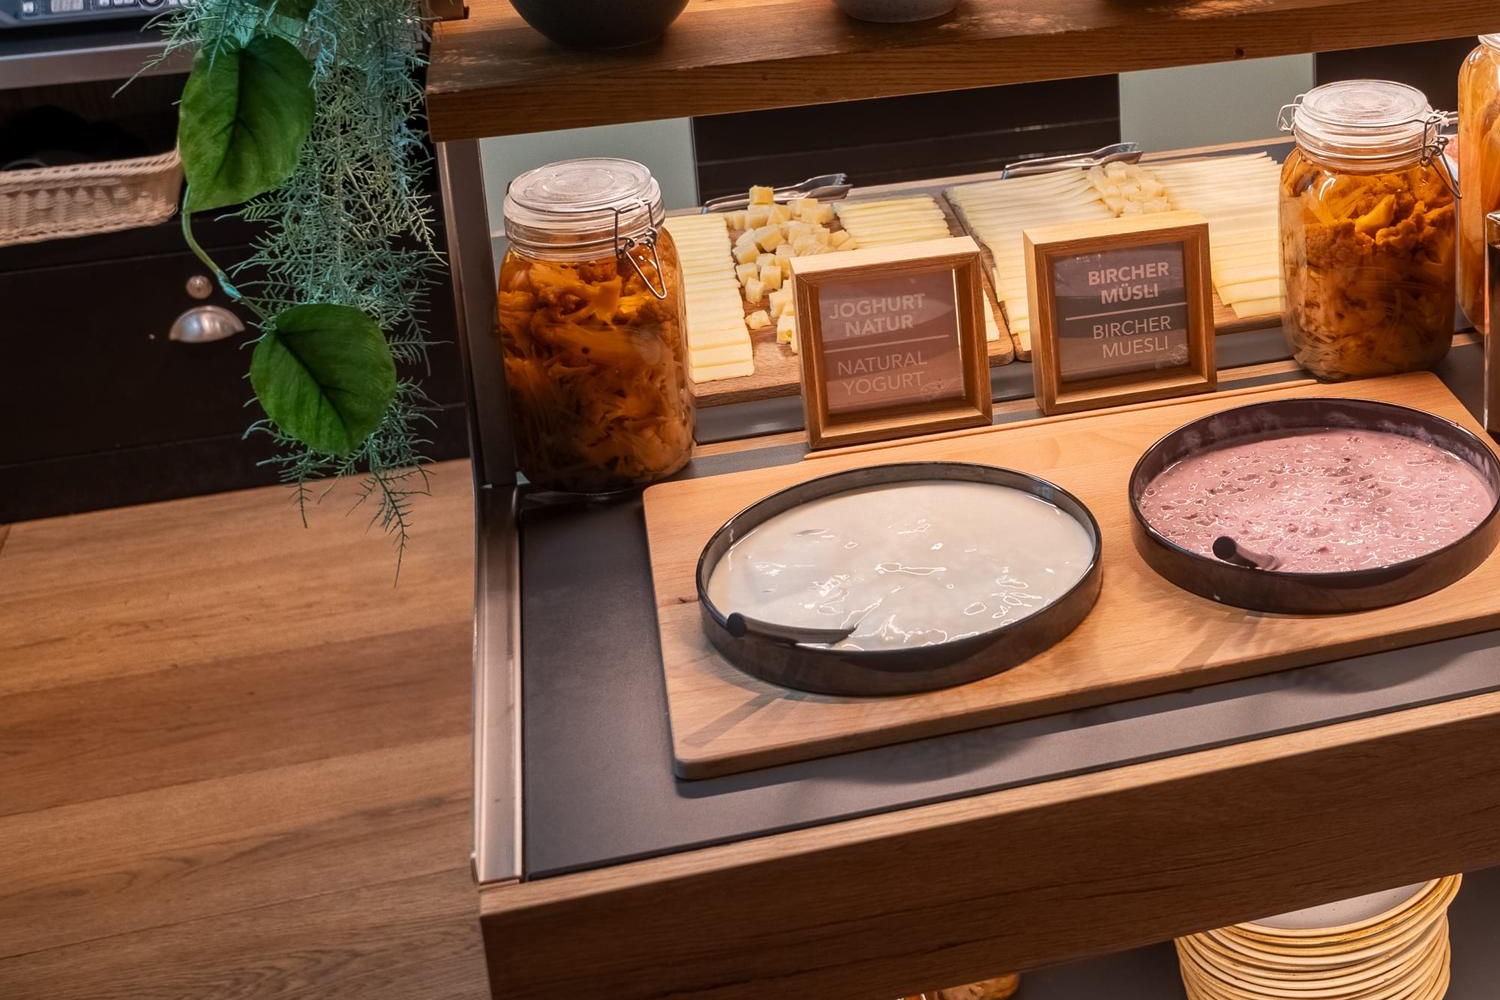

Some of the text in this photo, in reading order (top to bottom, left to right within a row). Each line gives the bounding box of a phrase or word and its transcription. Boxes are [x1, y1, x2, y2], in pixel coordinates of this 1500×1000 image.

[1088, 262, 1170, 286] BIRCHER
[1101, 283, 1159, 305] MÜSLI
[828, 293, 926, 320] JOGHURT
[845, 314, 914, 337] NATUR
[1093, 315, 1172, 340] BIRCHER
[1102, 336, 1168, 359] MUESLI
[838, 351, 928, 376] NATURAL
[842, 371, 925, 395] YOGURT
